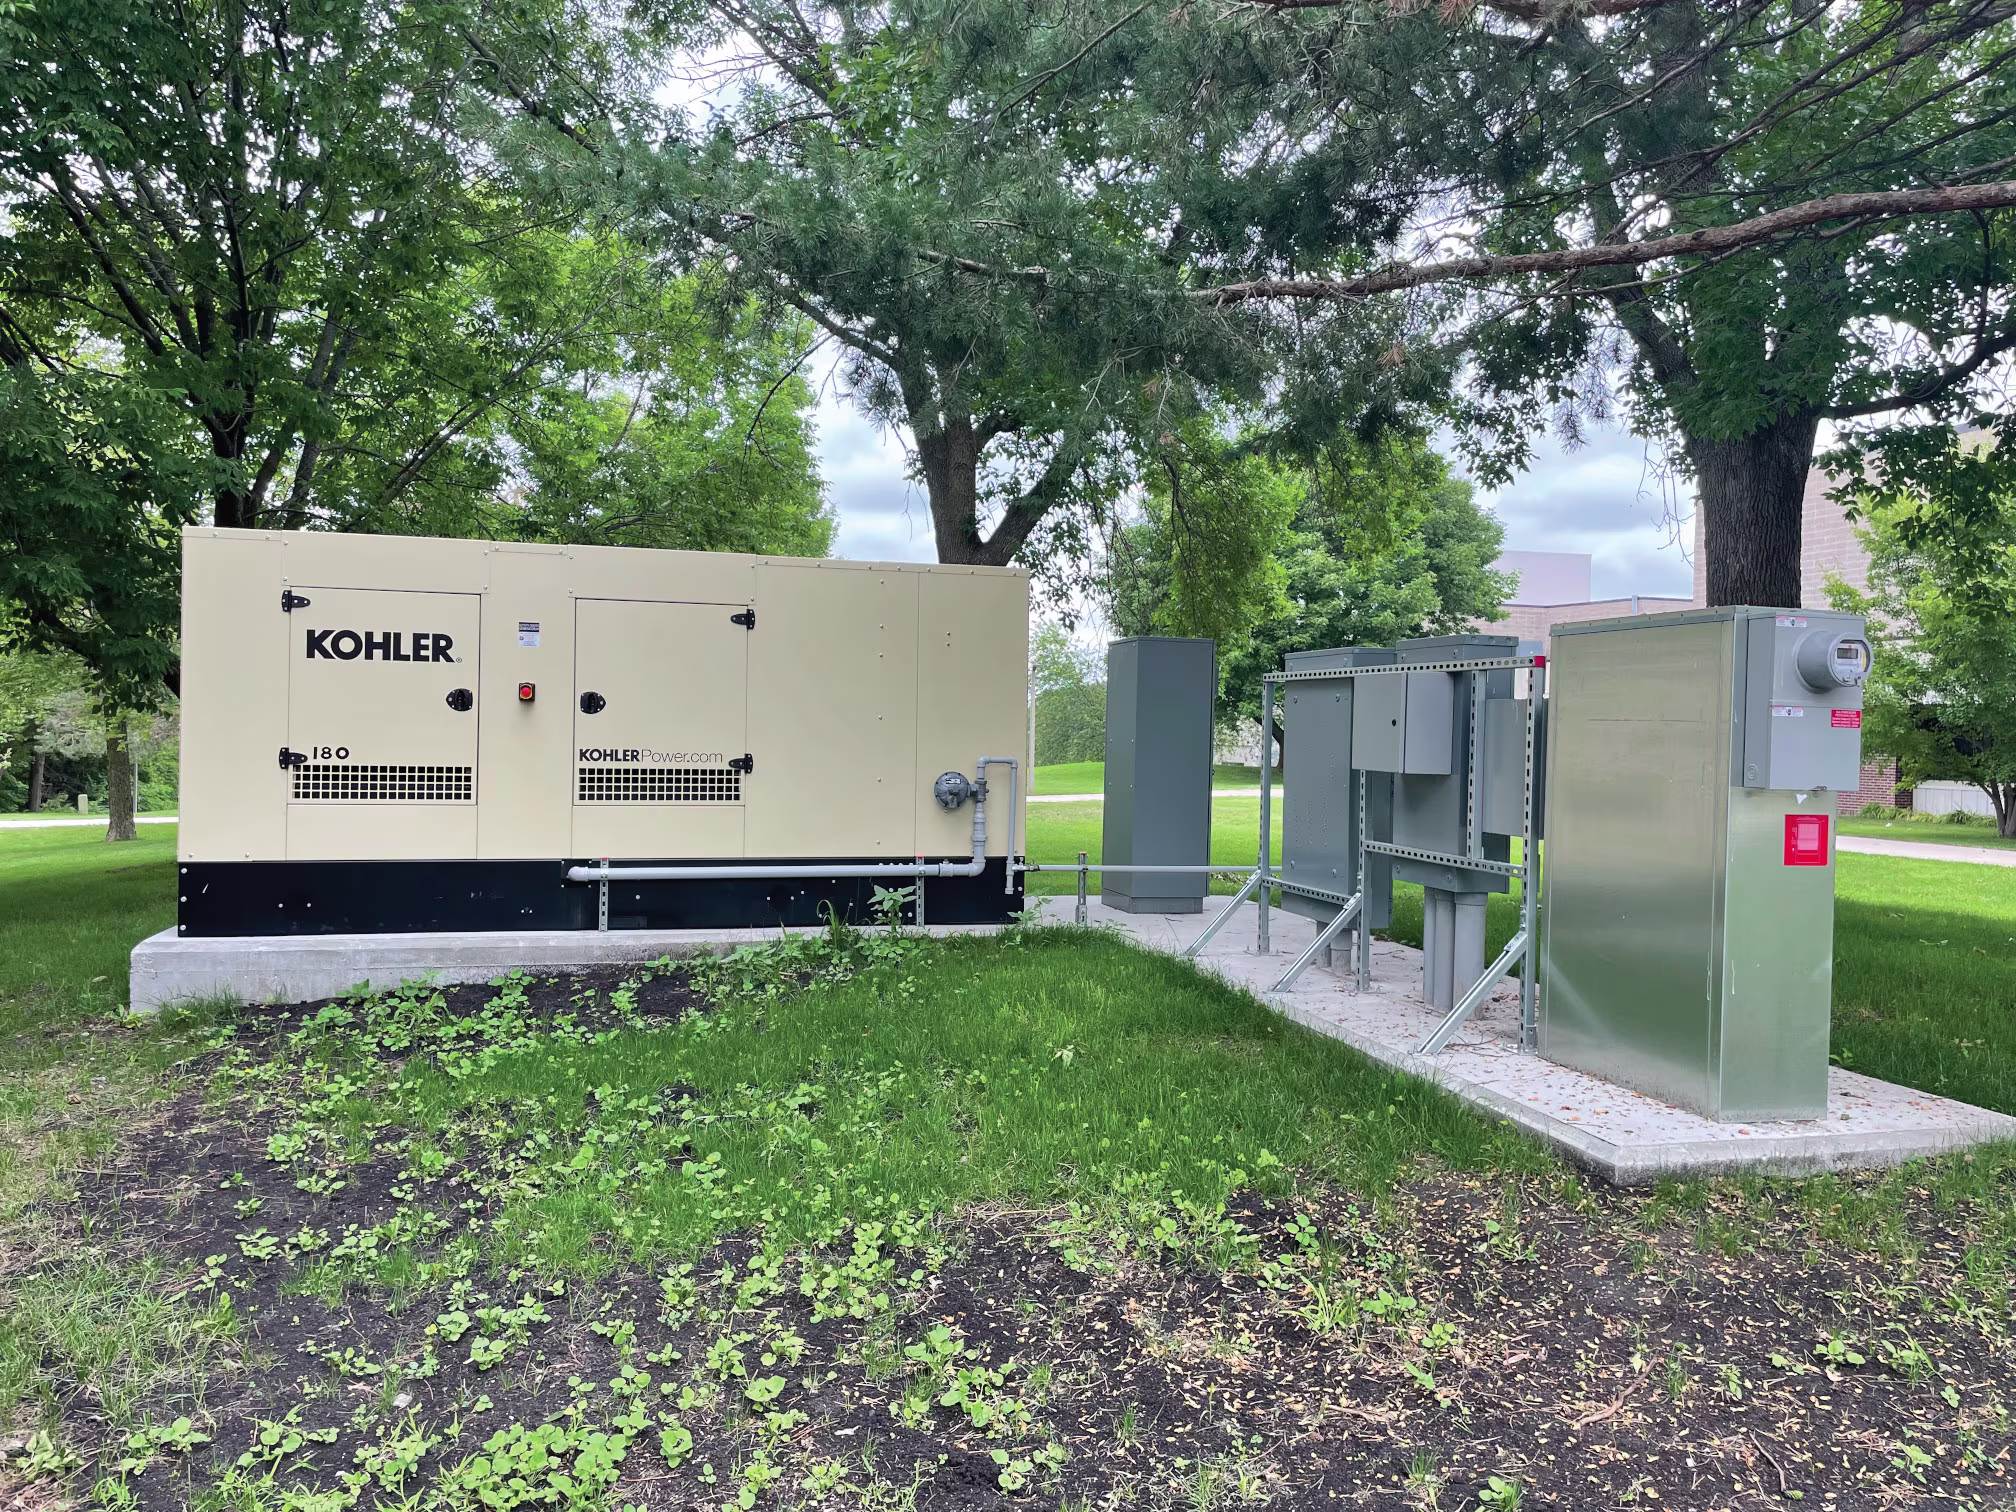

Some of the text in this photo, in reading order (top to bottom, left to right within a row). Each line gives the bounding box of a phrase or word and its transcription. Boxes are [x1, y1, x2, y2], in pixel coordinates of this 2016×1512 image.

[306, 629, 456, 663] KOHLER
[312, 746, 350, 760] 180
[579, 748, 723, 764] KOHLERPower.com
